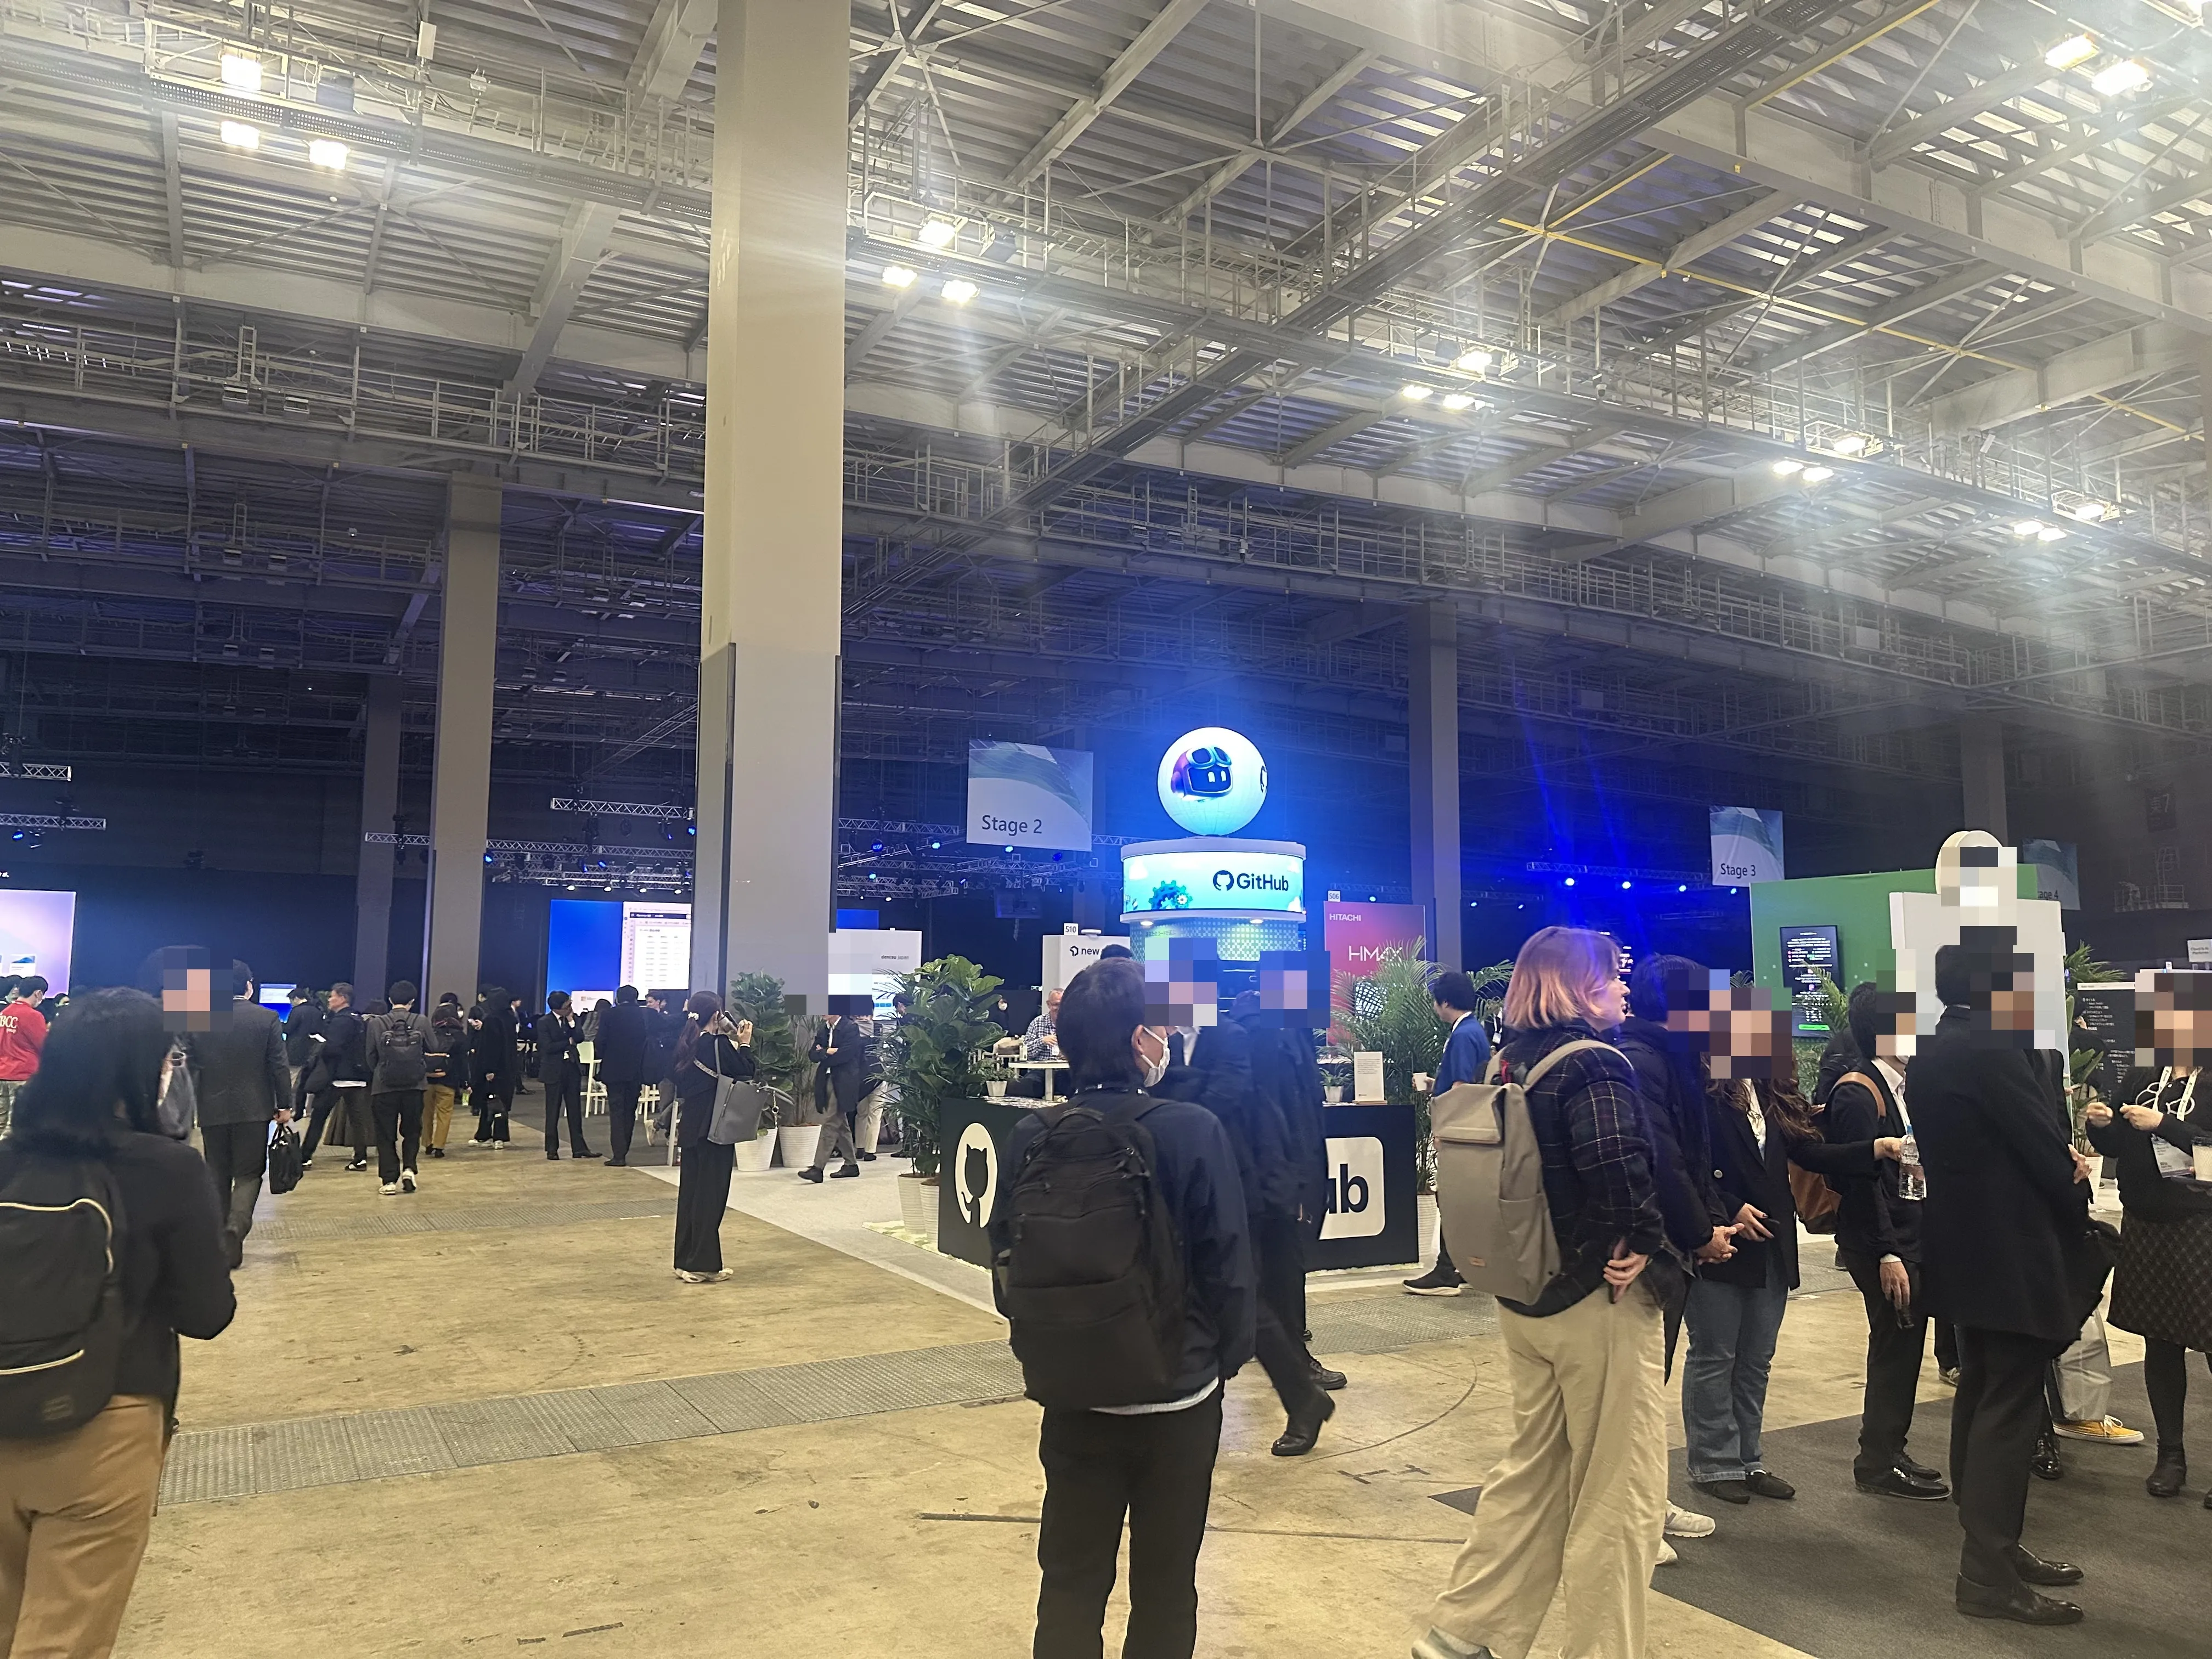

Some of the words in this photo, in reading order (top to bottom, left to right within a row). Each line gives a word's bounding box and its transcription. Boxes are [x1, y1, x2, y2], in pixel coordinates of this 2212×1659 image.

[982, 815, 1028, 836] Stage
[1033, 819, 1042, 833] 2
[1720, 863, 1747, 879] Stage
[1751, 865, 1756, 876] 3
[1237, 873, 1289, 891] GitHub
[2054, 890, 2059, 899] 4
[1329, 913, 1361, 922] HITACHI
